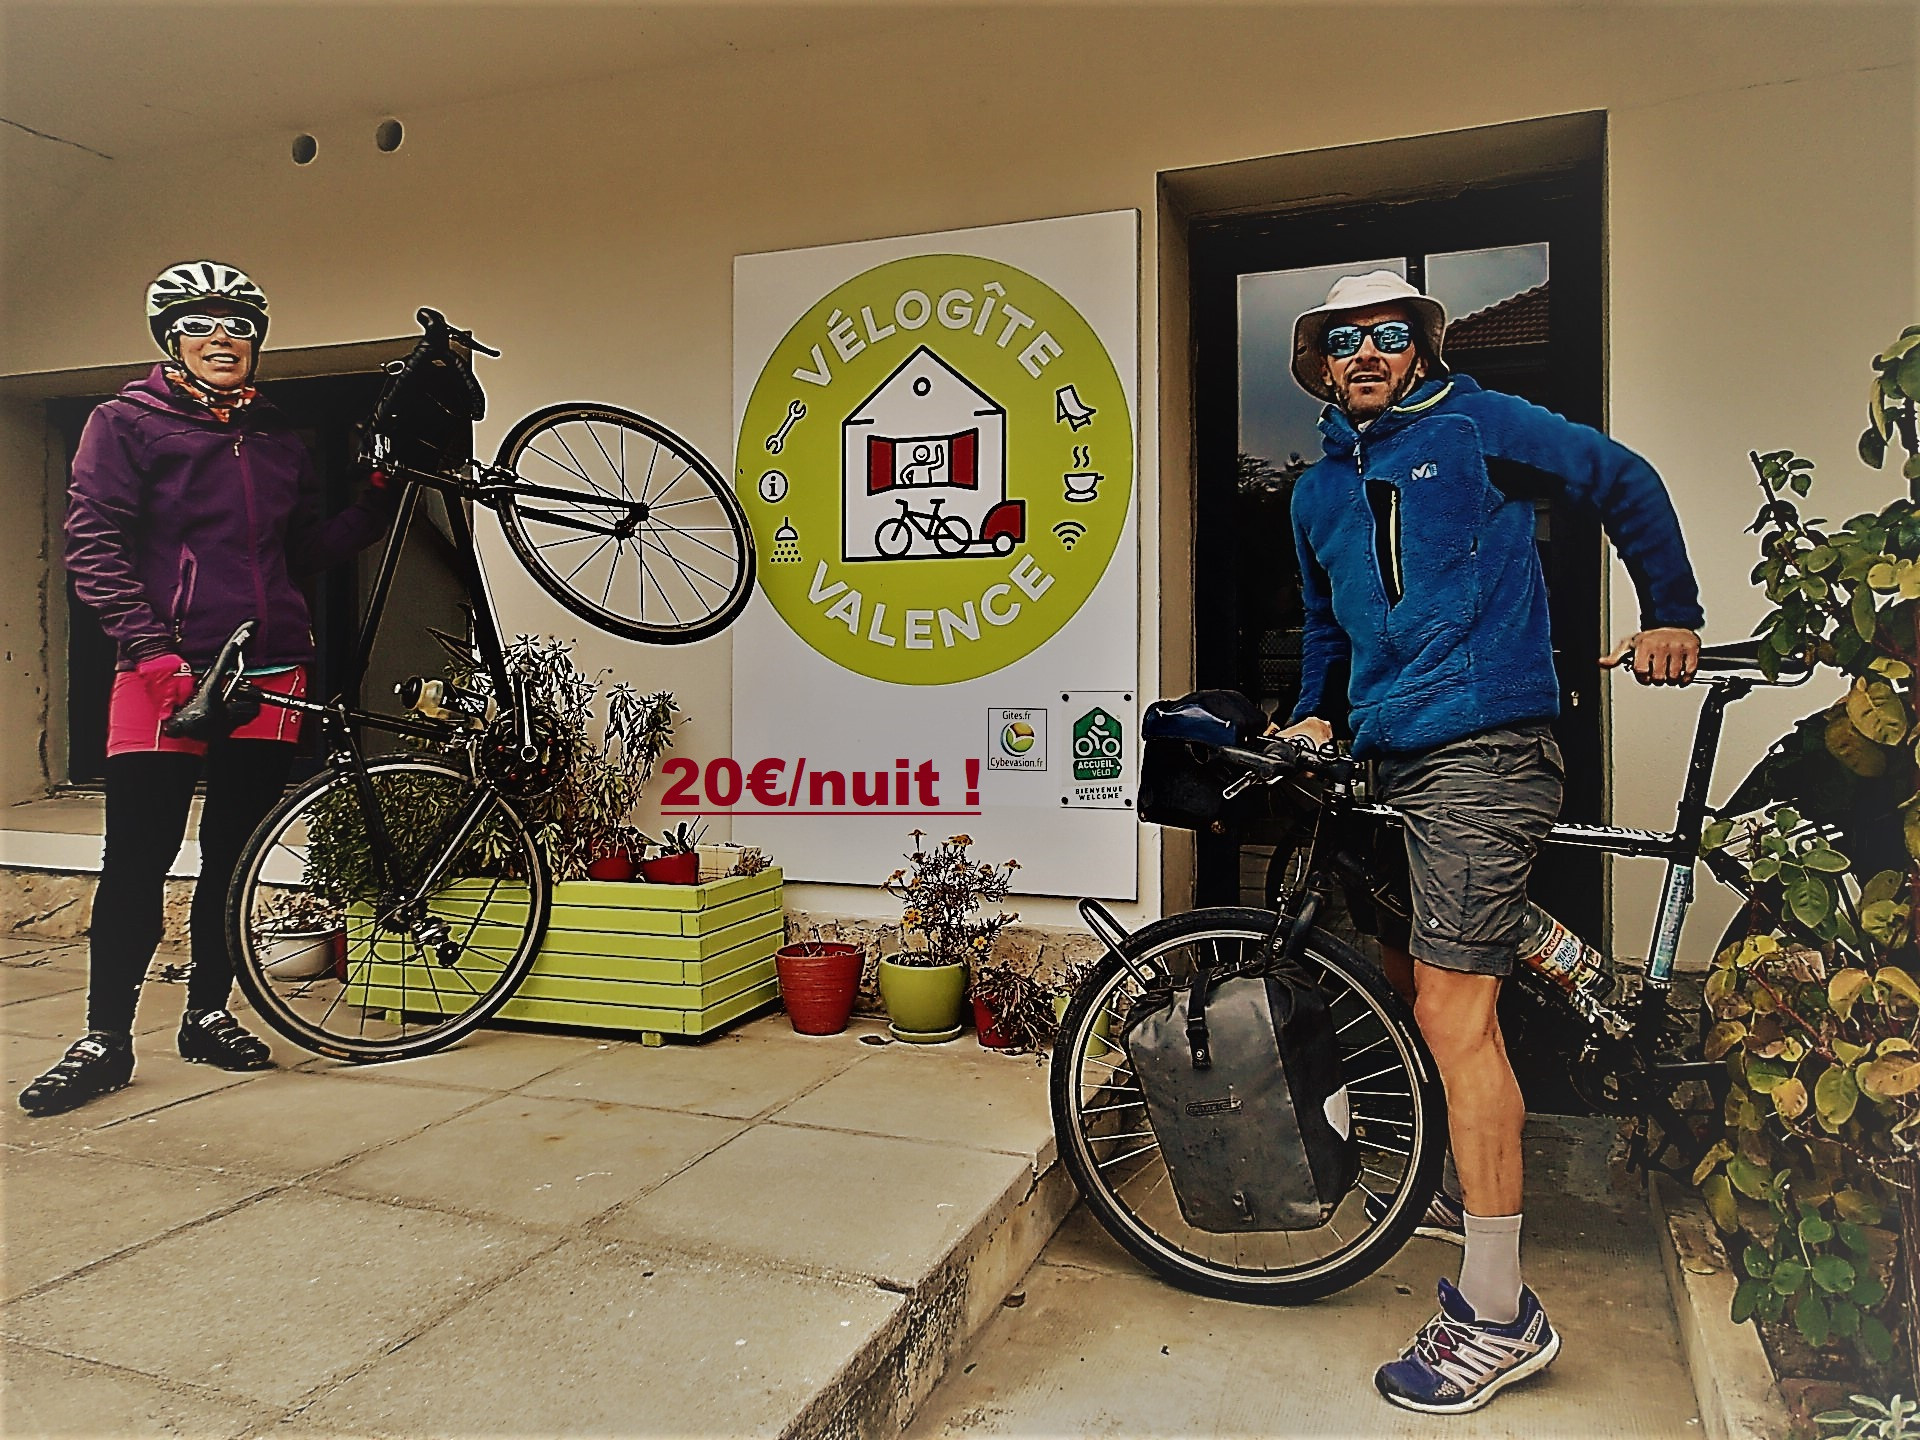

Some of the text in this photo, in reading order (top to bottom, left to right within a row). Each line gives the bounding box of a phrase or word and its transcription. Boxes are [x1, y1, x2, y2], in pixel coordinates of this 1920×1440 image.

[792, 281, 1064, 387] VÉLOGÎTE
[807, 554, 1056, 650] VALENCE
[1002, 711, 1031, 720] Gites.fr
[990, 757, 1043, 768] Cybevasion.fr
[1077, 760, 1115, 769] ACCUEIL
[1075, 785, 1123, 795] BIENVENUE
[1078, 793, 1119, 801] WELCOME
